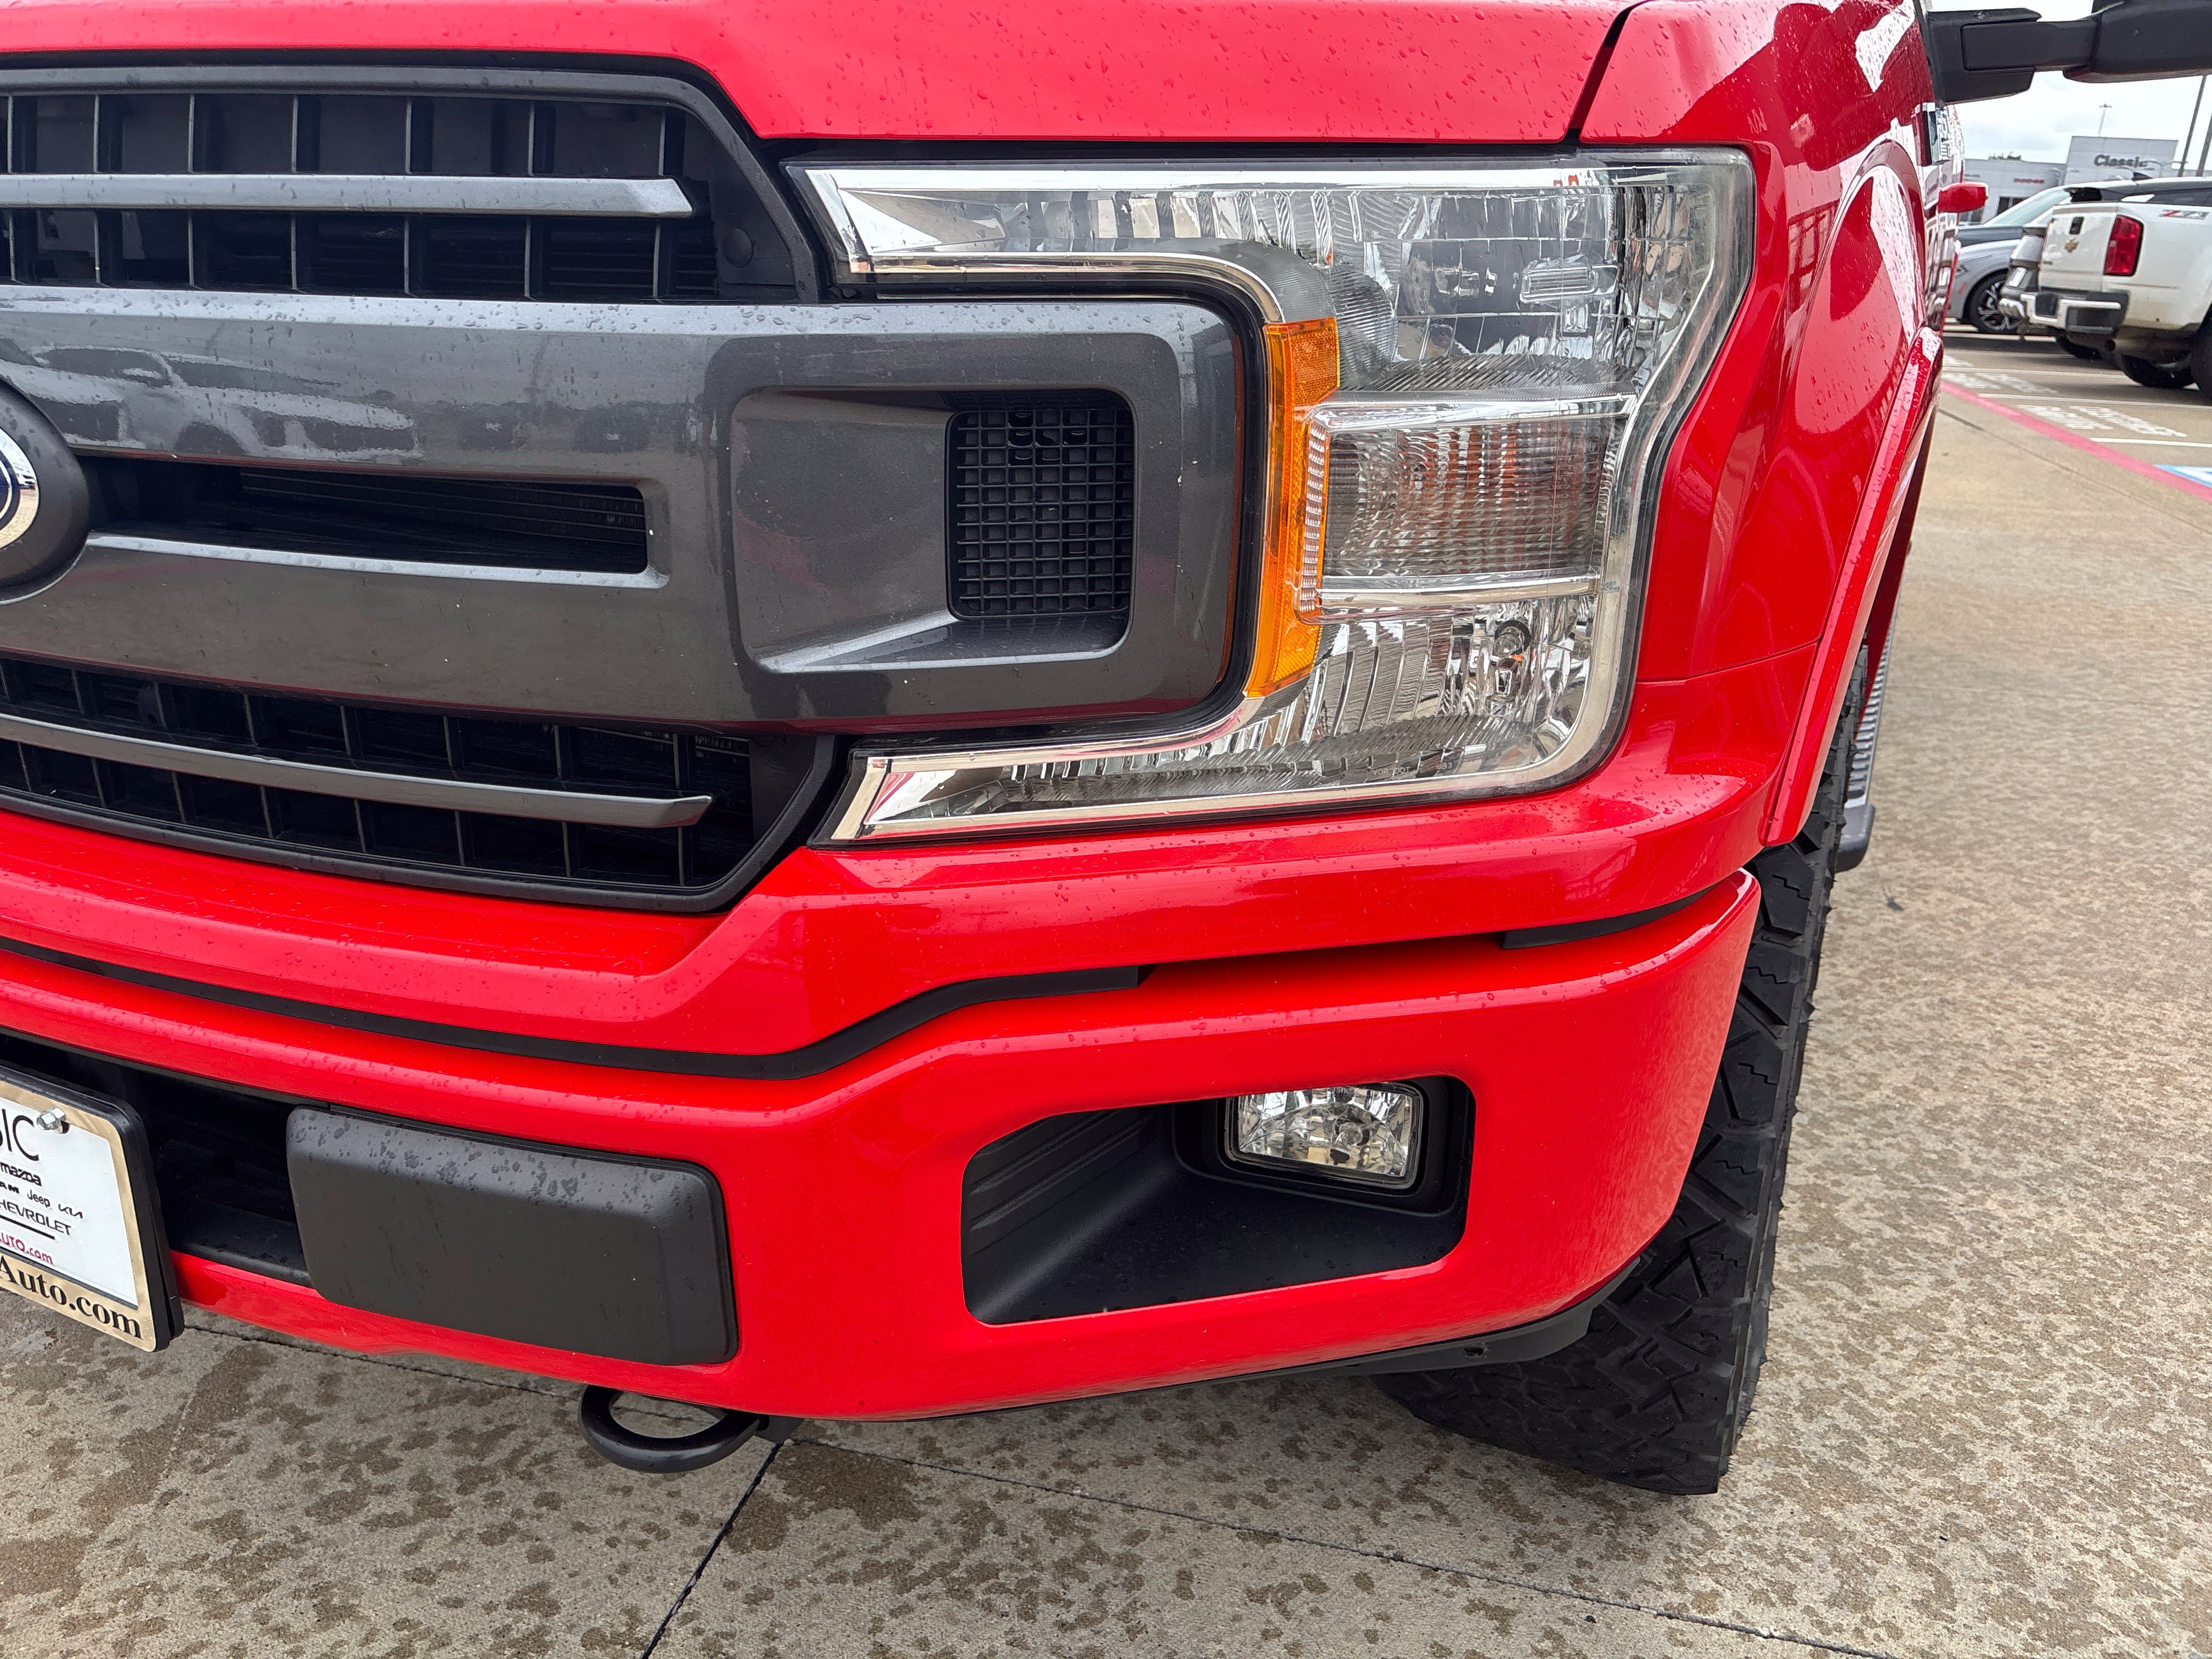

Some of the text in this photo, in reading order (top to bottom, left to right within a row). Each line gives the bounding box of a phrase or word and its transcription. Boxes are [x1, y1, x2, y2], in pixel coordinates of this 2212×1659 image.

[2094, 154, 2147, 167] Classic
[0, 1161, 42, 1187] mazda
[27, 1189, 50, 1209] Jeep
[0, 1255, 144, 1340] Auto.com
